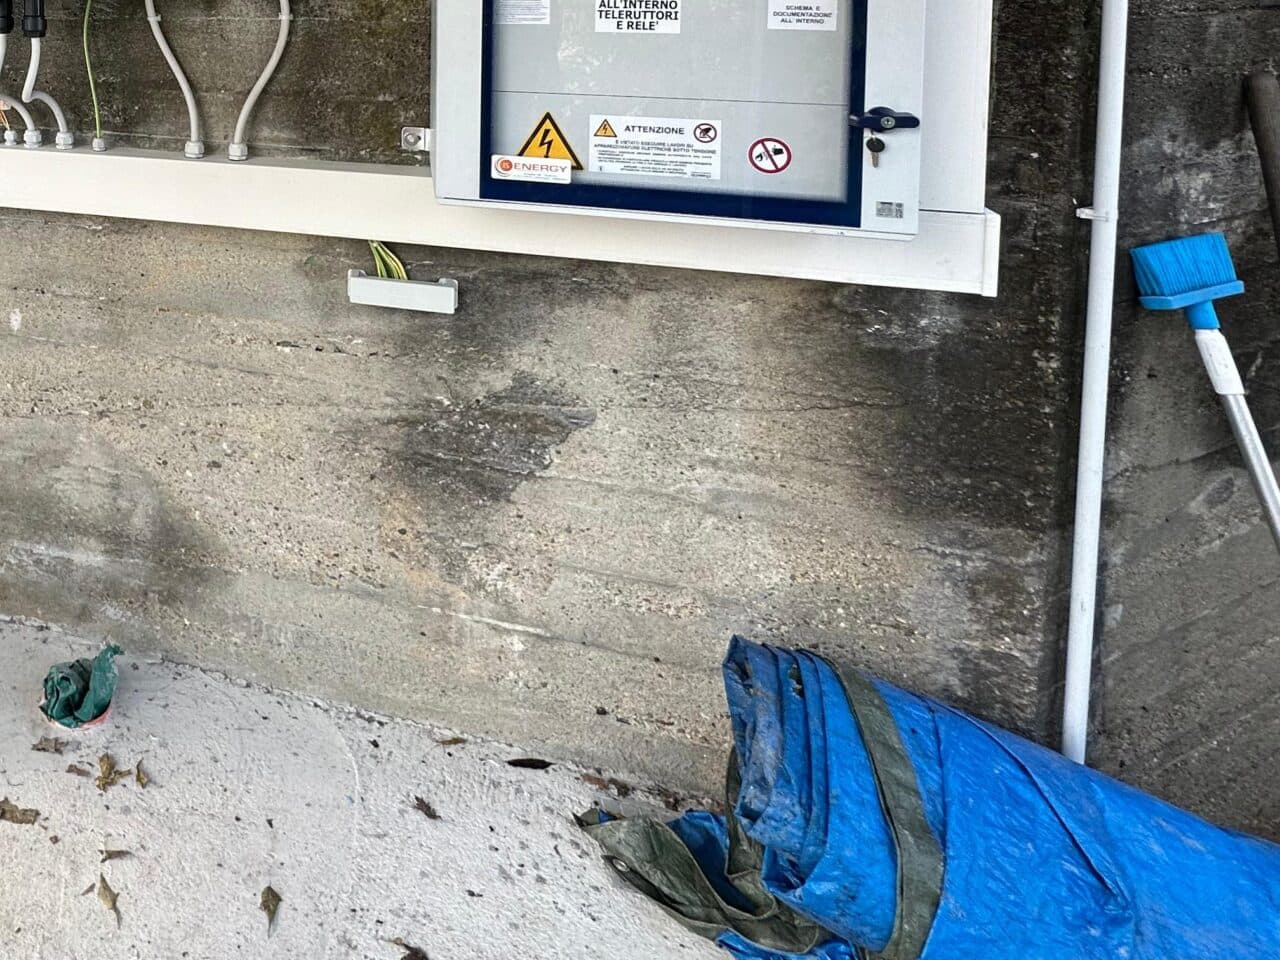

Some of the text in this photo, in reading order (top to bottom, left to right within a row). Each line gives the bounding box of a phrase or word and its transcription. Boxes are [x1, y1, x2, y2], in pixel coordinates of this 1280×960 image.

[598, 0, 678, 10] ALL'INTERNO
[597, 9, 679, 21] TELERUTTORI
[616, 20, 659, 31] E RELE'
[624, 125, 685, 135] ATTENZIONE
[513, 162, 568, 173] ENERGY
